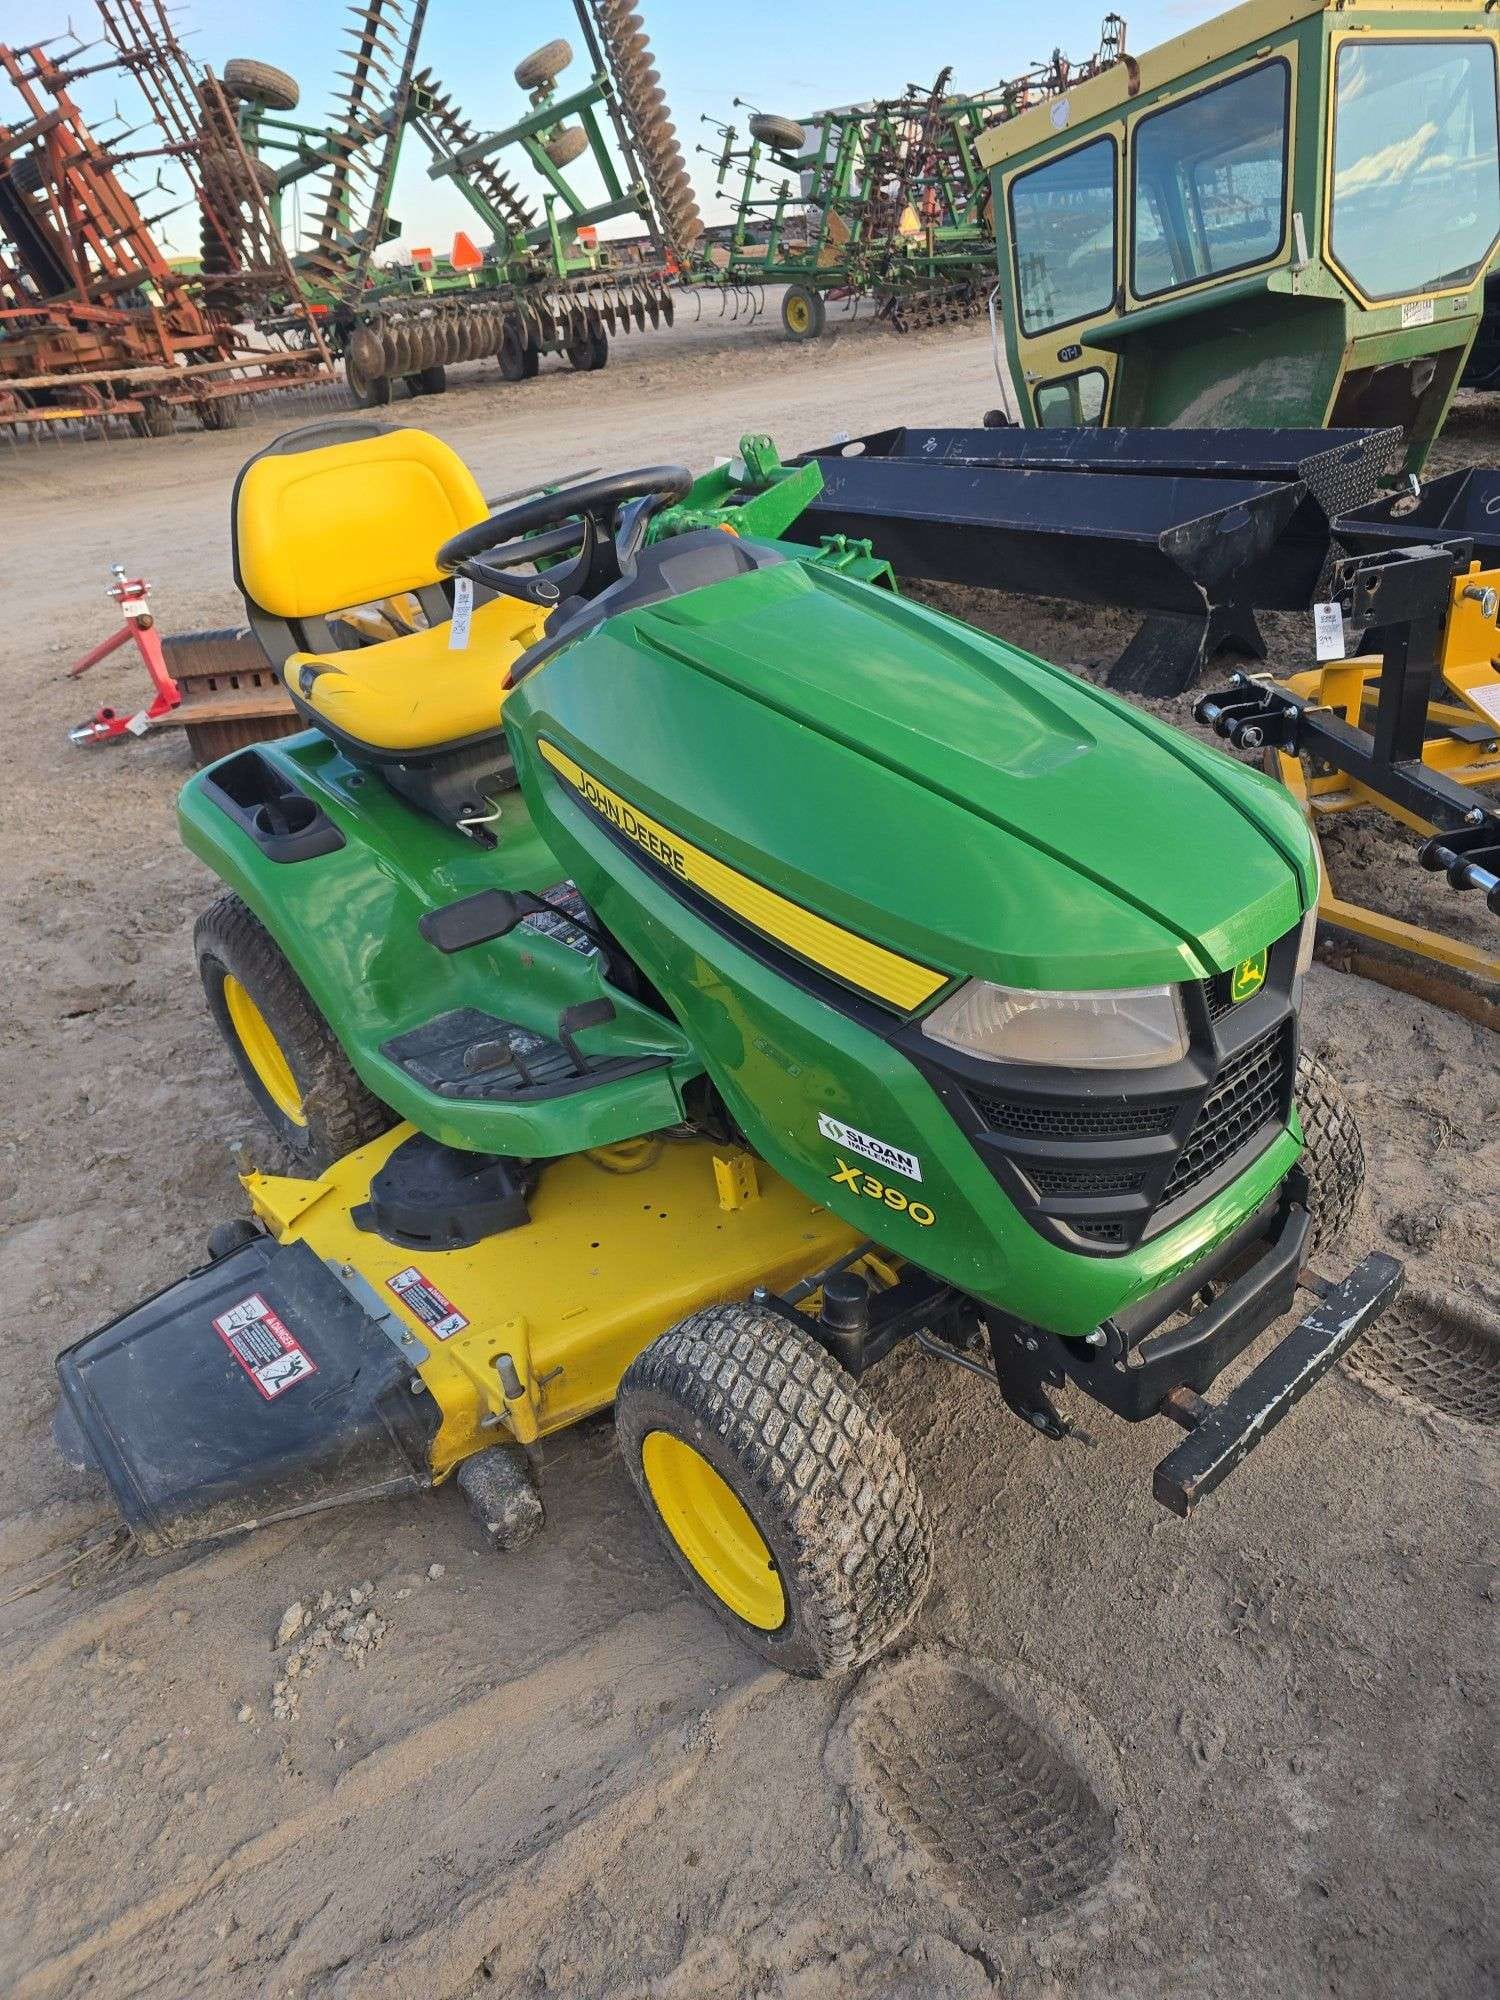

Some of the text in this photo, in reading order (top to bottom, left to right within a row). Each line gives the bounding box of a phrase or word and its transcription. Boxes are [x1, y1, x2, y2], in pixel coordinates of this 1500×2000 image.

[578, 770, 686, 877] JOHN DEERE
[846, 1130, 913, 1168] SLOAN
[848, 1140, 915, 1176] IMPLEMENT
[830, 1156, 936, 1227] X390
[271, 1320, 295, 1348] DANGER
